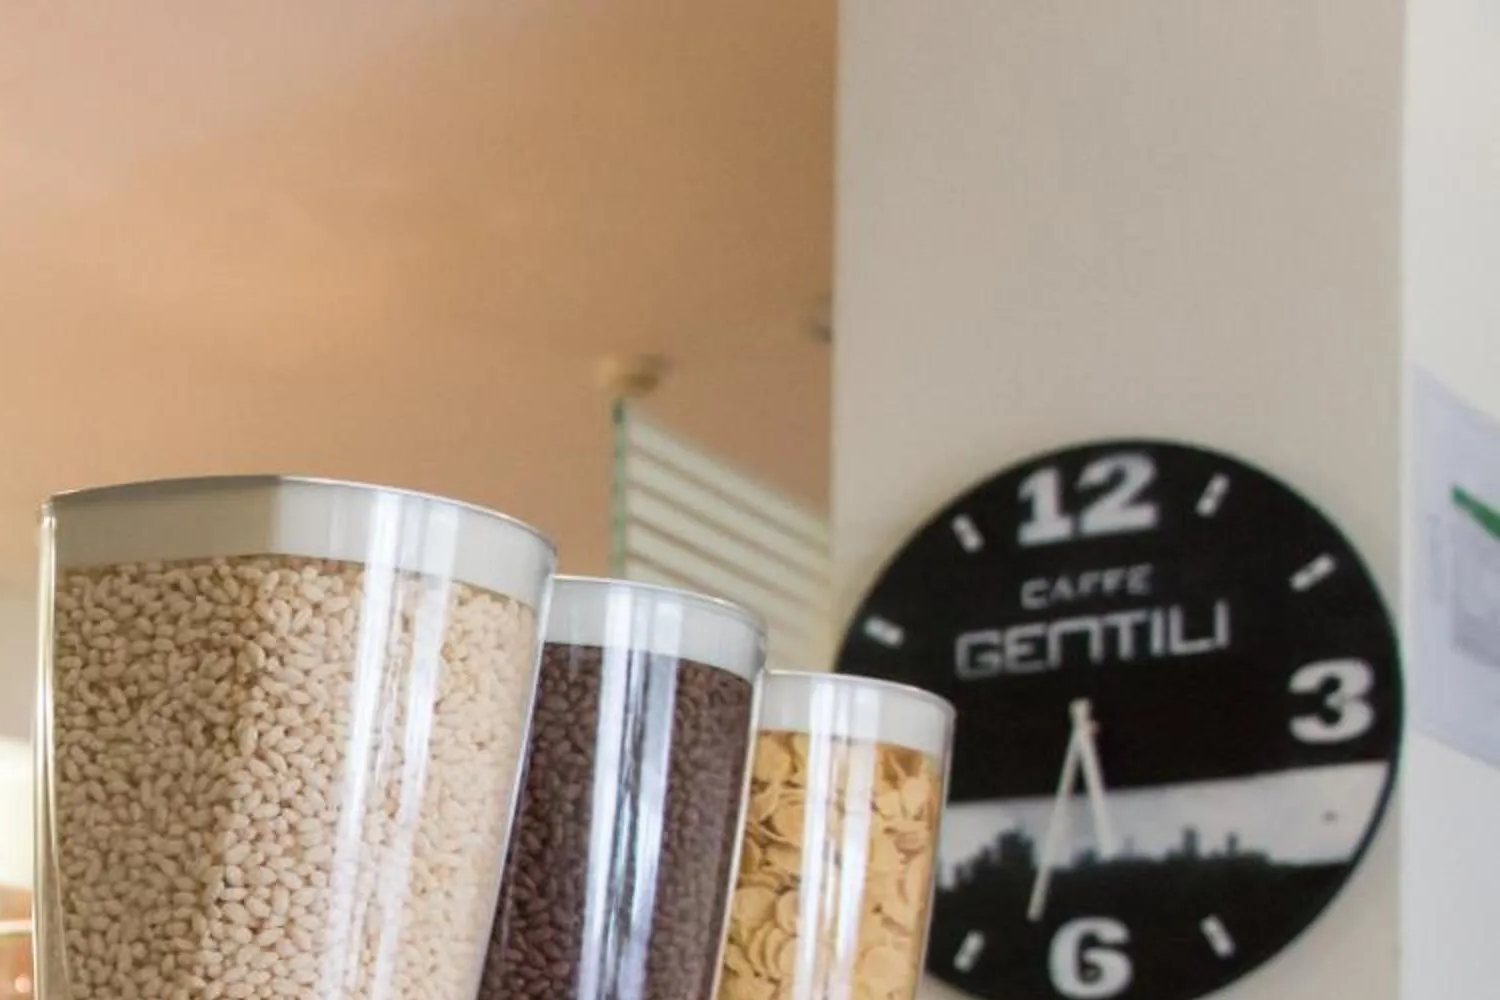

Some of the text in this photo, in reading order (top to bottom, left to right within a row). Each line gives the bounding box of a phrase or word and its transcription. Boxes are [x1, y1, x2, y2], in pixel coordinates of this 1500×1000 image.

[1017, 454, 1159, 546] 12
[955, 601, 1230, 678] GENTILI
[1288, 659, 1376, 744] 3
